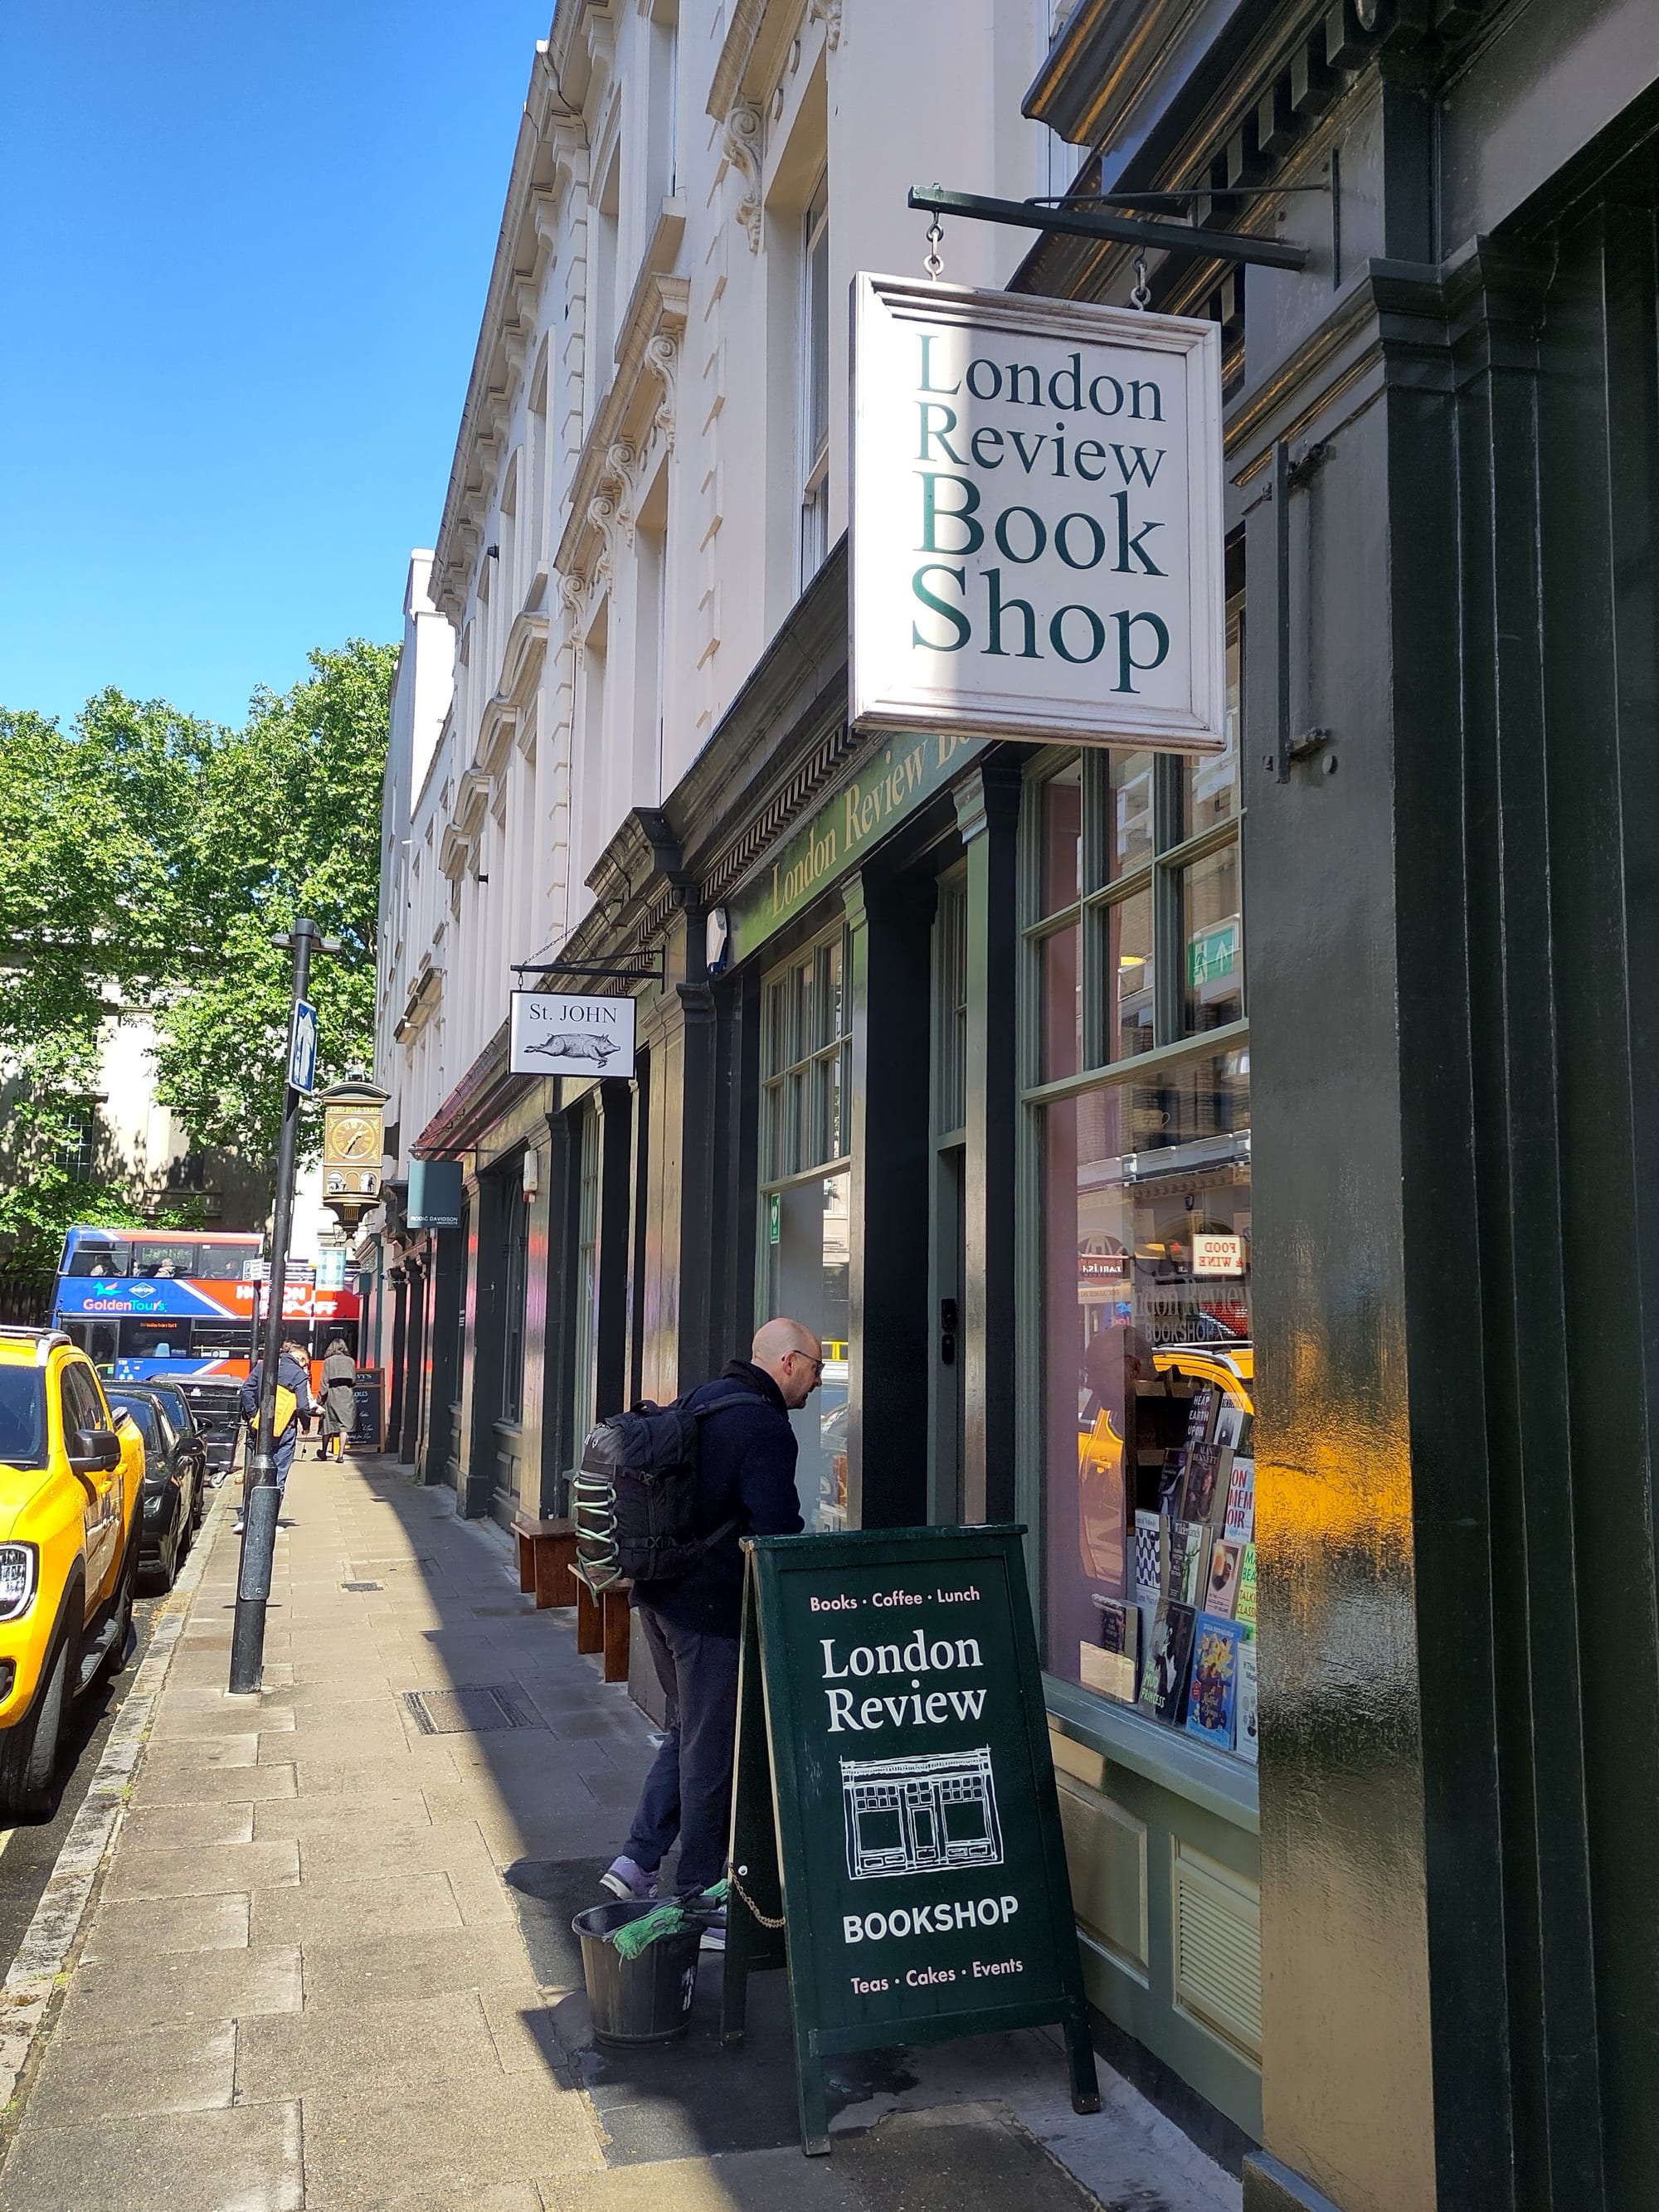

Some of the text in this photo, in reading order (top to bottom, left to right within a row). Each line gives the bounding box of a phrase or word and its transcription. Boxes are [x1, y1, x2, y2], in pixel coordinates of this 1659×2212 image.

[915, 334, 1166, 422] London
[914, 401, 1168, 489] Review
[913, 470, 1169, 577] Book
[912, 564, 1170, 694] Shop
[771, 739, 928, 918] London Review
[529, 1003, 618, 1023] St. JOHN
[1146, 1321, 1215, 1343] BOOKSHOP
[1193, 1394, 1210, 1406] HEAP
[1189, 1410, 1209, 1422] EARTH
[1187, 1426, 1204, 1437] UPON
[1232, 1469, 1248, 1488] ON
[1228, 1489, 1253, 1510] MEM
[1227, 1509, 1245, 1529] OIR
[810, 1586, 980, 1612] Books Coffee Lunch
[820, 1629, 983, 1679] London
[1145, 1671, 1158, 1689] MUD
[825, 1680, 988, 1733] Review
[1141, 1688, 1165, 1709] PRINCESS
[843, 1895, 1019, 1944] BOOKSHOP
[851, 1958, 1024, 1994] Teas Cakes Events
